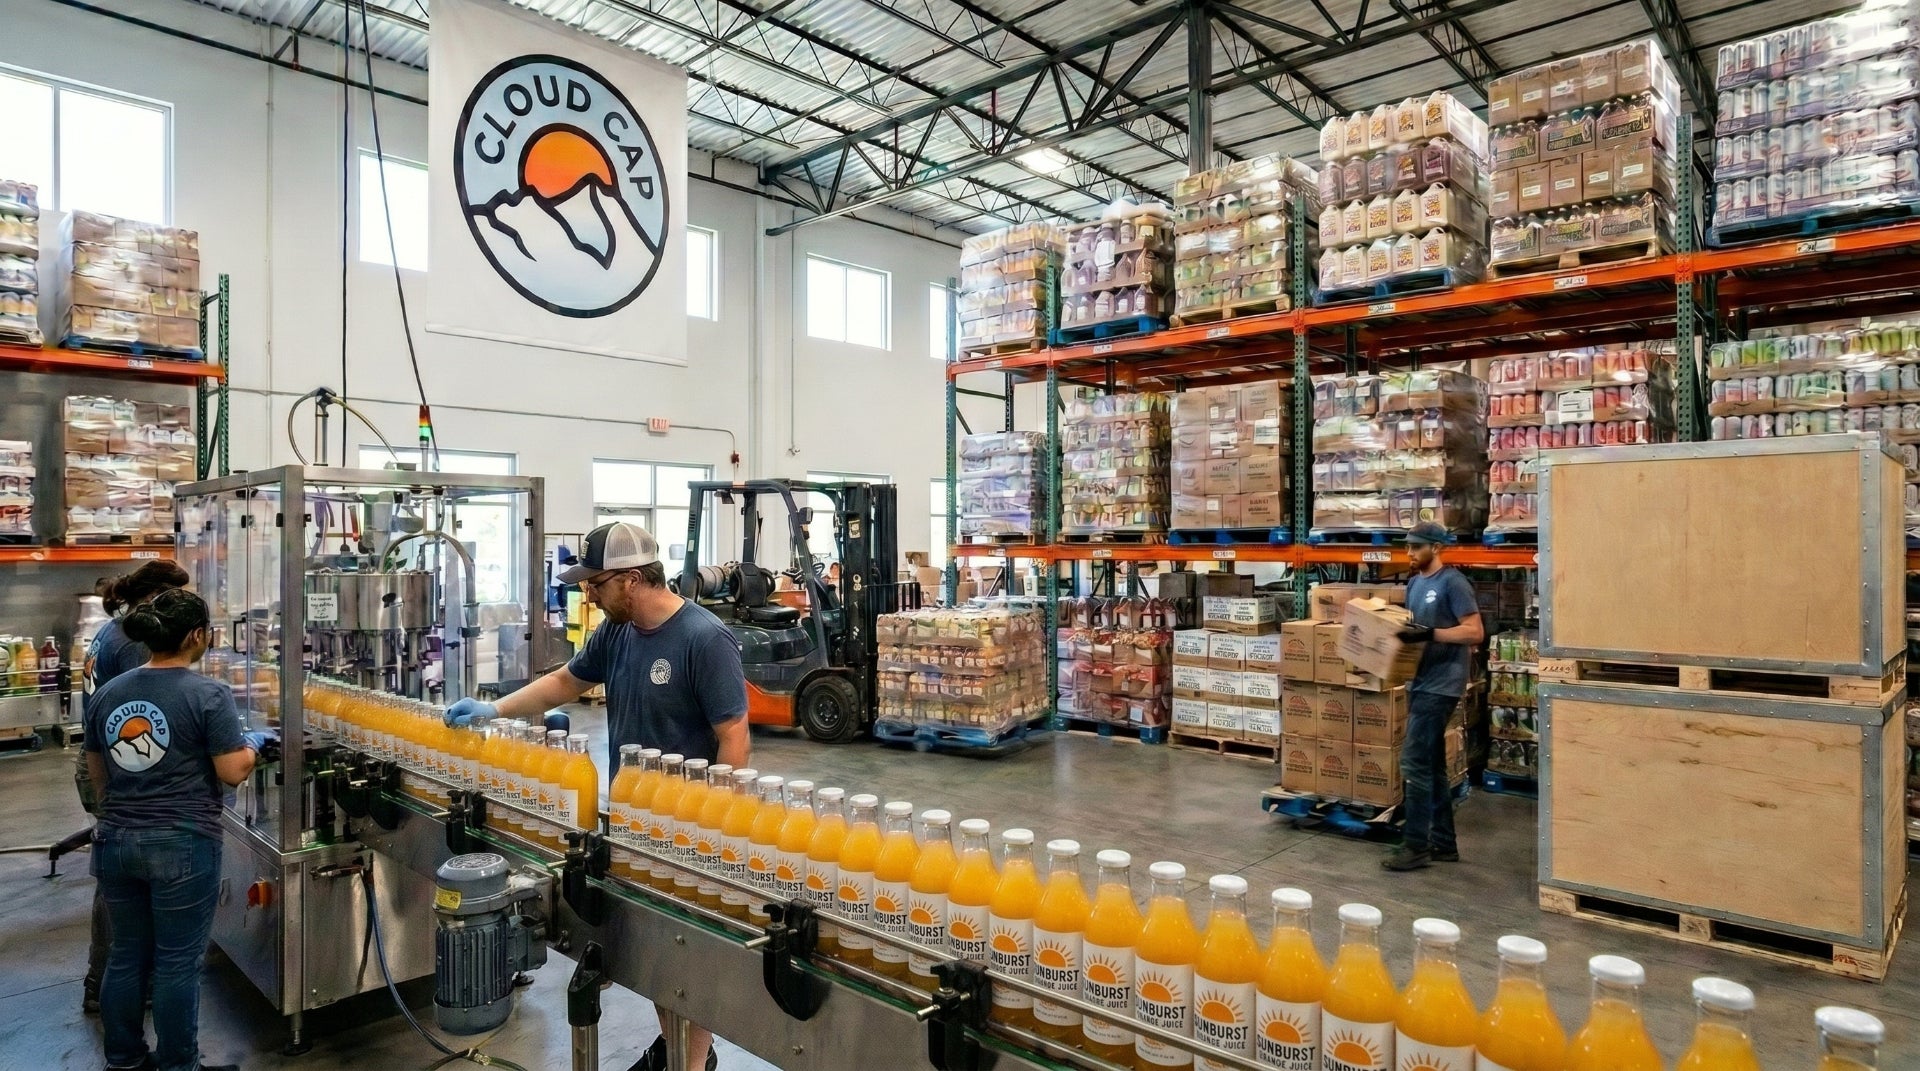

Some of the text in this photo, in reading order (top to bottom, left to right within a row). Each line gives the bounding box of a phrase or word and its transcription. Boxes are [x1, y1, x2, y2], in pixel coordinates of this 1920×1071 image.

[474, 75, 654, 200] CLOUD CAP
[150, 710, 166, 735] CAP
[1058, 983, 1078, 991] JUICE
[1161, 1021, 1183, 1029] JUICE
[1194, 1014, 1249, 1041] SUNBURST
[1223, 1041, 1246, 1050] JUICE
[1257, 1034, 1316, 1062] SUNBURST
[1289, 1062, 1313, 1071] JUICE
